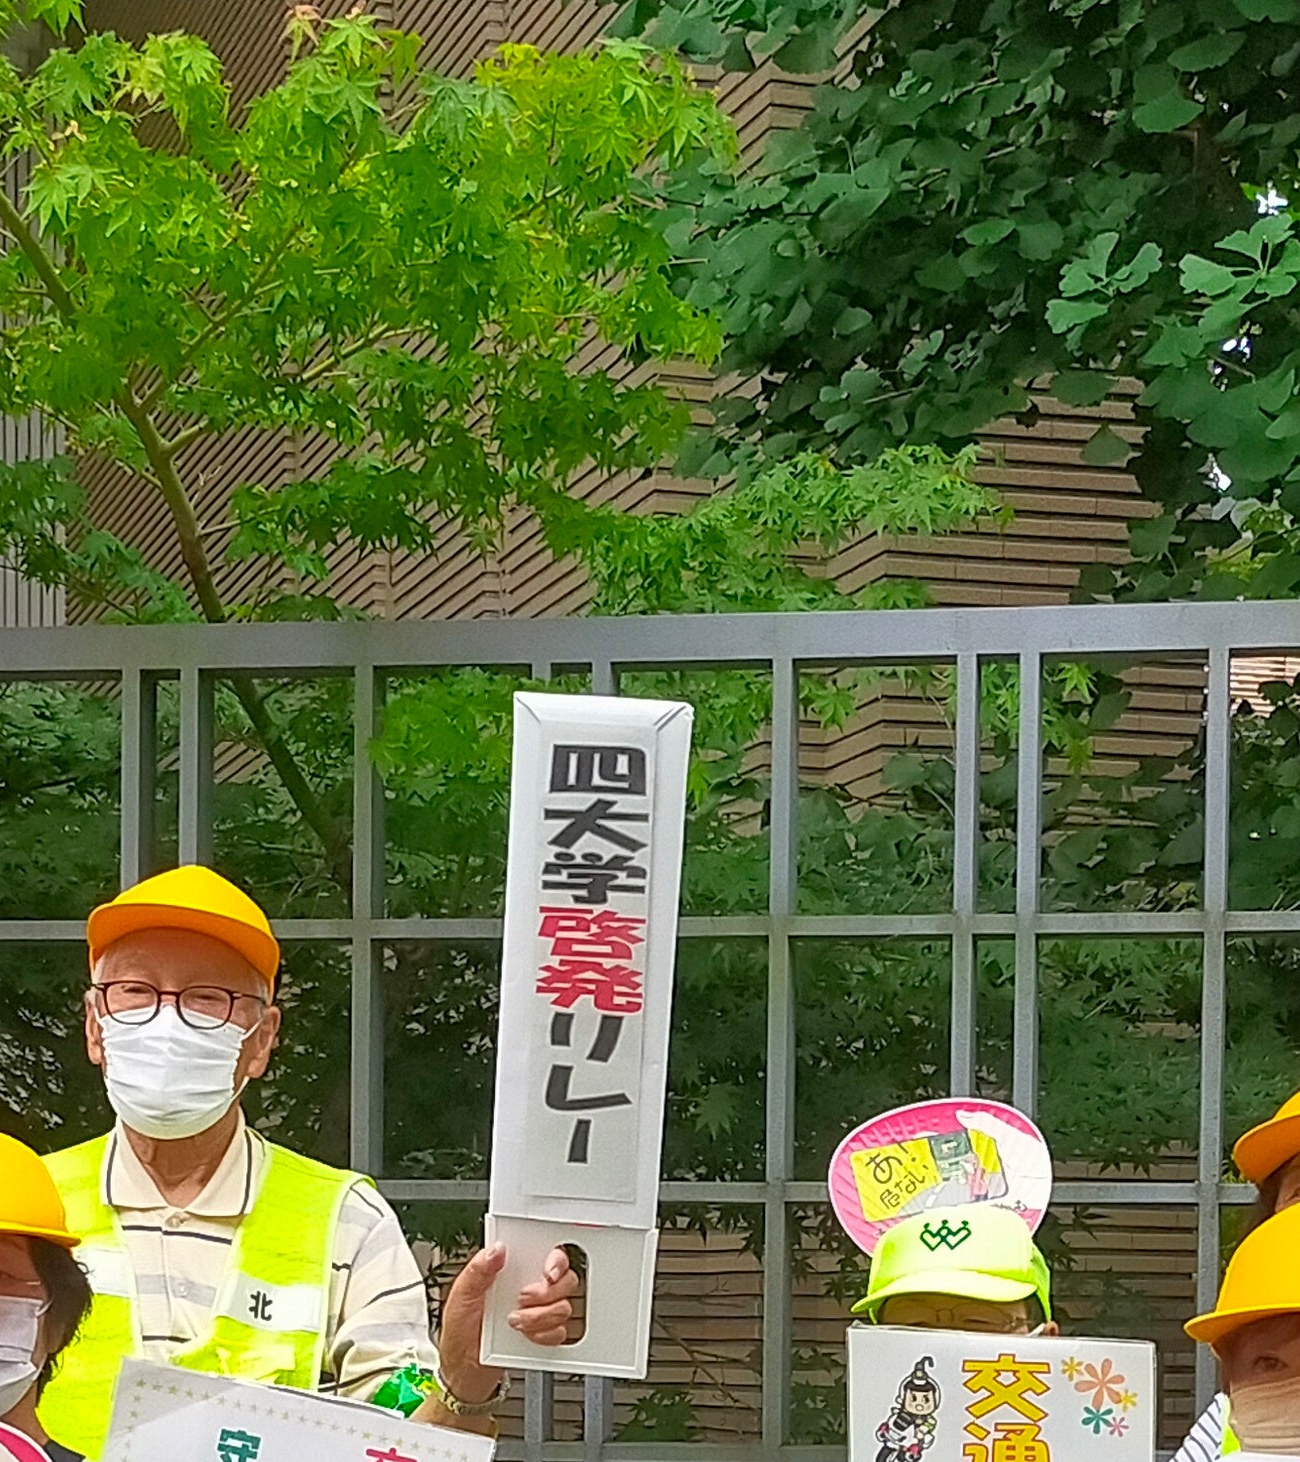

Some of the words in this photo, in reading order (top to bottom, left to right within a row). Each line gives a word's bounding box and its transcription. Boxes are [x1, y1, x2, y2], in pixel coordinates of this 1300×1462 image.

[536, 743, 650, 1165] 四大学啓発リレー
[249, 1290, 273, 1321] 北
